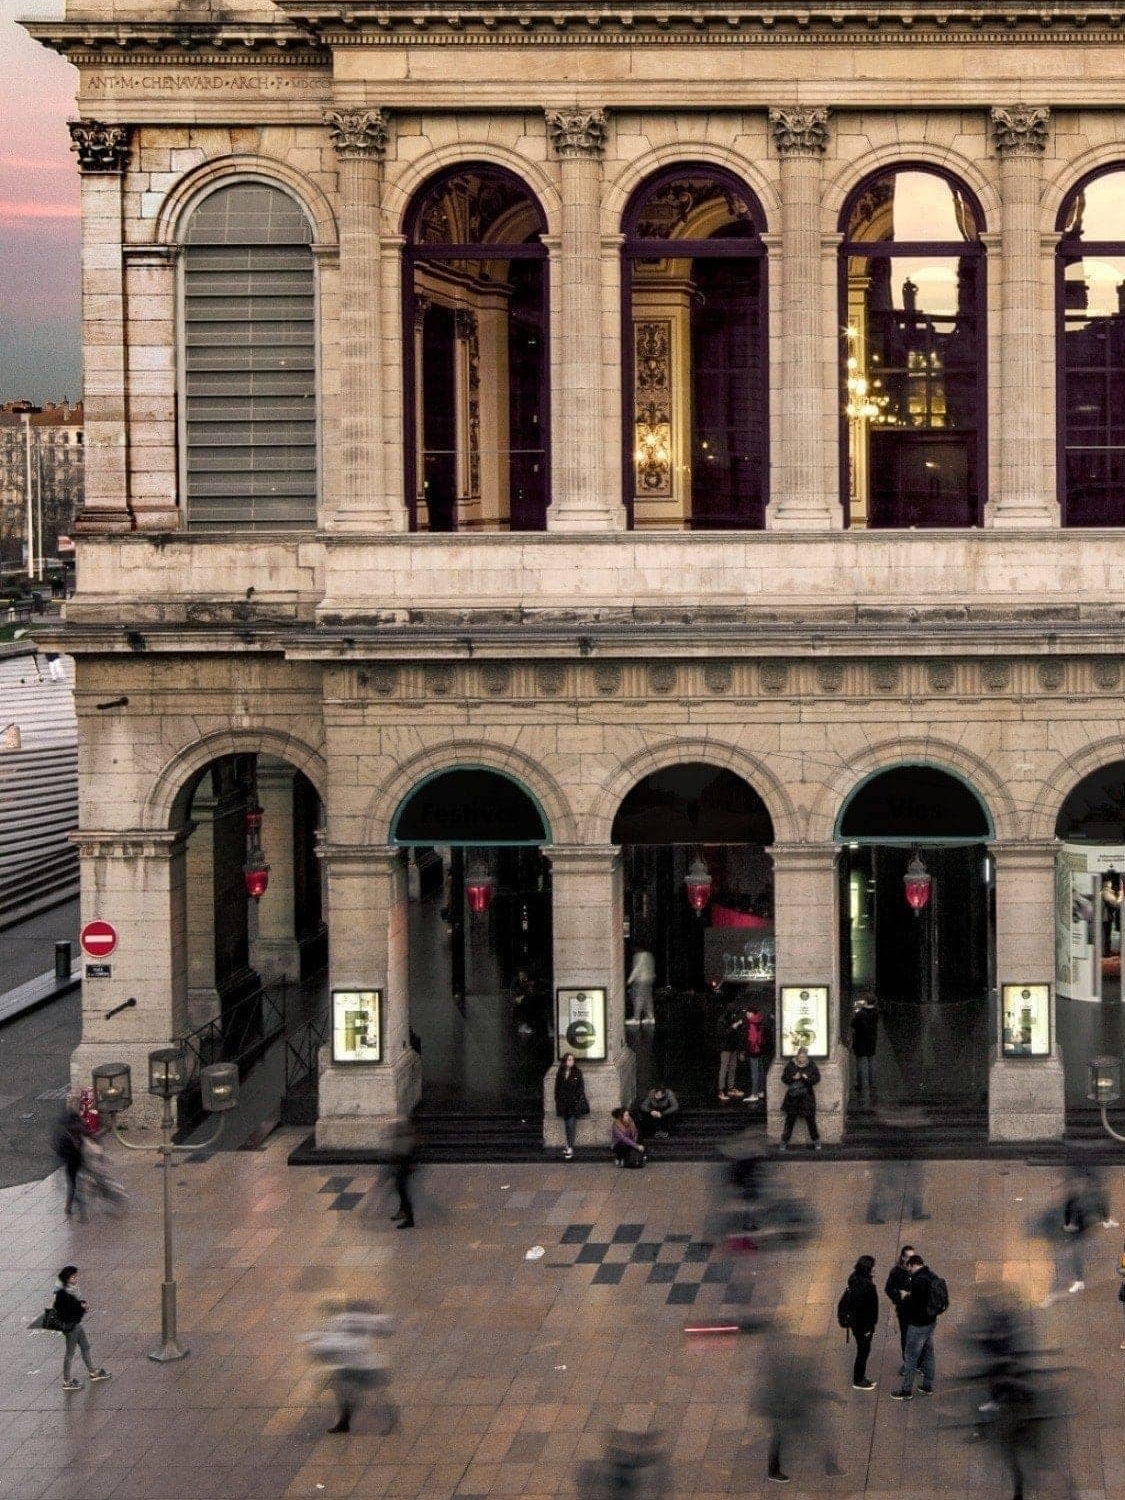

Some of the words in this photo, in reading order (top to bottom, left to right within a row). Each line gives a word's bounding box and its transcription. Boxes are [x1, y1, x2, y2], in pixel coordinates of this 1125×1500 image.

[420, 801, 519, 825] Festival
[886, 796, 943, 821] Vies
[566, 1020, 597, 1050] e
